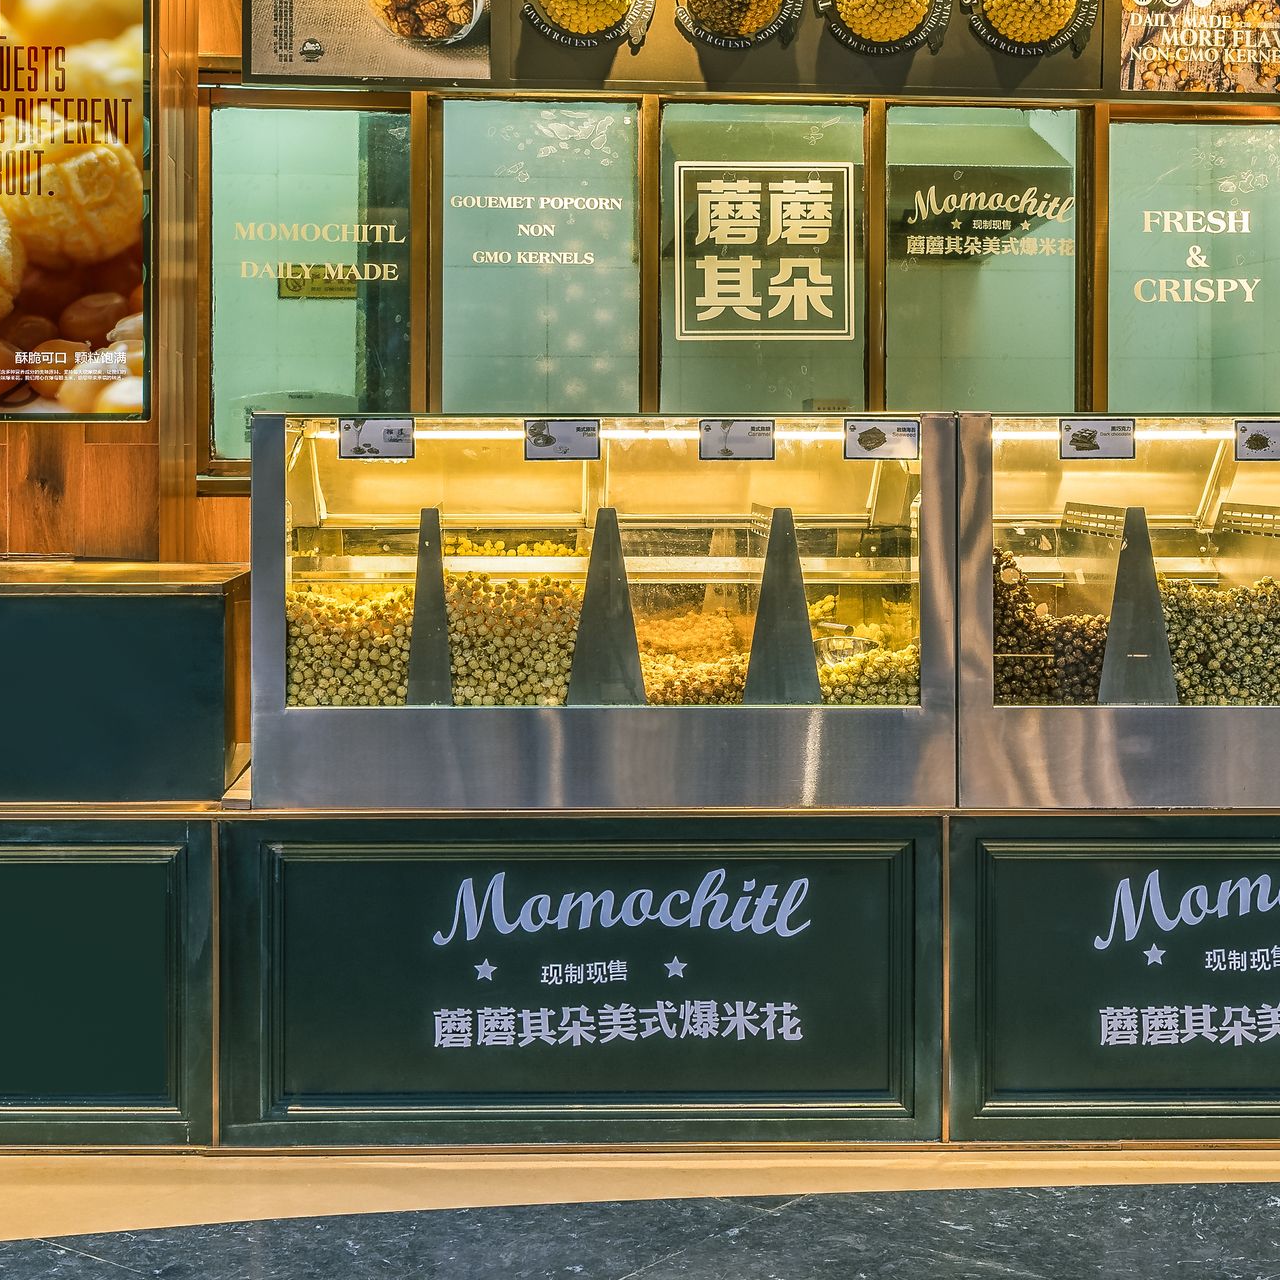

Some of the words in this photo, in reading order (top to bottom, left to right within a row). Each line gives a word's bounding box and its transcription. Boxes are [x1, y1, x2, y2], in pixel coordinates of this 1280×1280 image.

[523, 4, 540, 26] GIVE
[540, 24, 559, 41] OUR
[560, 36, 598, 47] GUESTS
[677, 8, 694, 30] GIVE
[694, 26, 713, 43] OUR
[715, 37, 752, 48] GUESTS
[831, 23, 848, 43] GIVE
[904, 6, 944, 49] SOMETHING
[1050, 7, 1088, 49] SOMETHING
[1130, 13, 1179, 27] DAILY
[1182, 15, 1232, 29] MADE
[971, 15, 987, 36] GIVE
[987, 33, 1007, 51] OUR
[1007, 46, 1044, 55] GUESTS
[1161, 29, 1226, 47] MORE
[1129, 47, 1220, 63] NON-GMO
[15, 98, 133, 144] DIFFERENT
[450, 195, 536, 210] GOUEMET
[539, 195, 623, 211] POPCORN
[907, 185, 1075, 224] Momochitl
[233, 221, 406, 244] MOMOCHITL
[517, 223, 556, 238] NON
[972, 219, 1012, 231] 现制现售
[1142, 209, 1252, 234] FRESH
[472, 250, 511, 265] GMO
[516, 250, 595, 266] KERNELS
[906, 235, 1075, 257] 蘑蘑其朵美式爆米花
[1185, 244, 1209, 269] &
[240, 261, 314, 280] DAILY
[322, 262, 400, 281] MADE
[1132, 278, 1263, 304] CRISPY
[14, 352, 67, 365] 酥脆可口
[74, 352, 127, 365] 颗粒饱满
[432, 867, 812, 946] Momochitl
[540, 958, 628, 986] 现制现售
[433, 999, 804, 1049] 蘑蘑其朵美式爆米花
